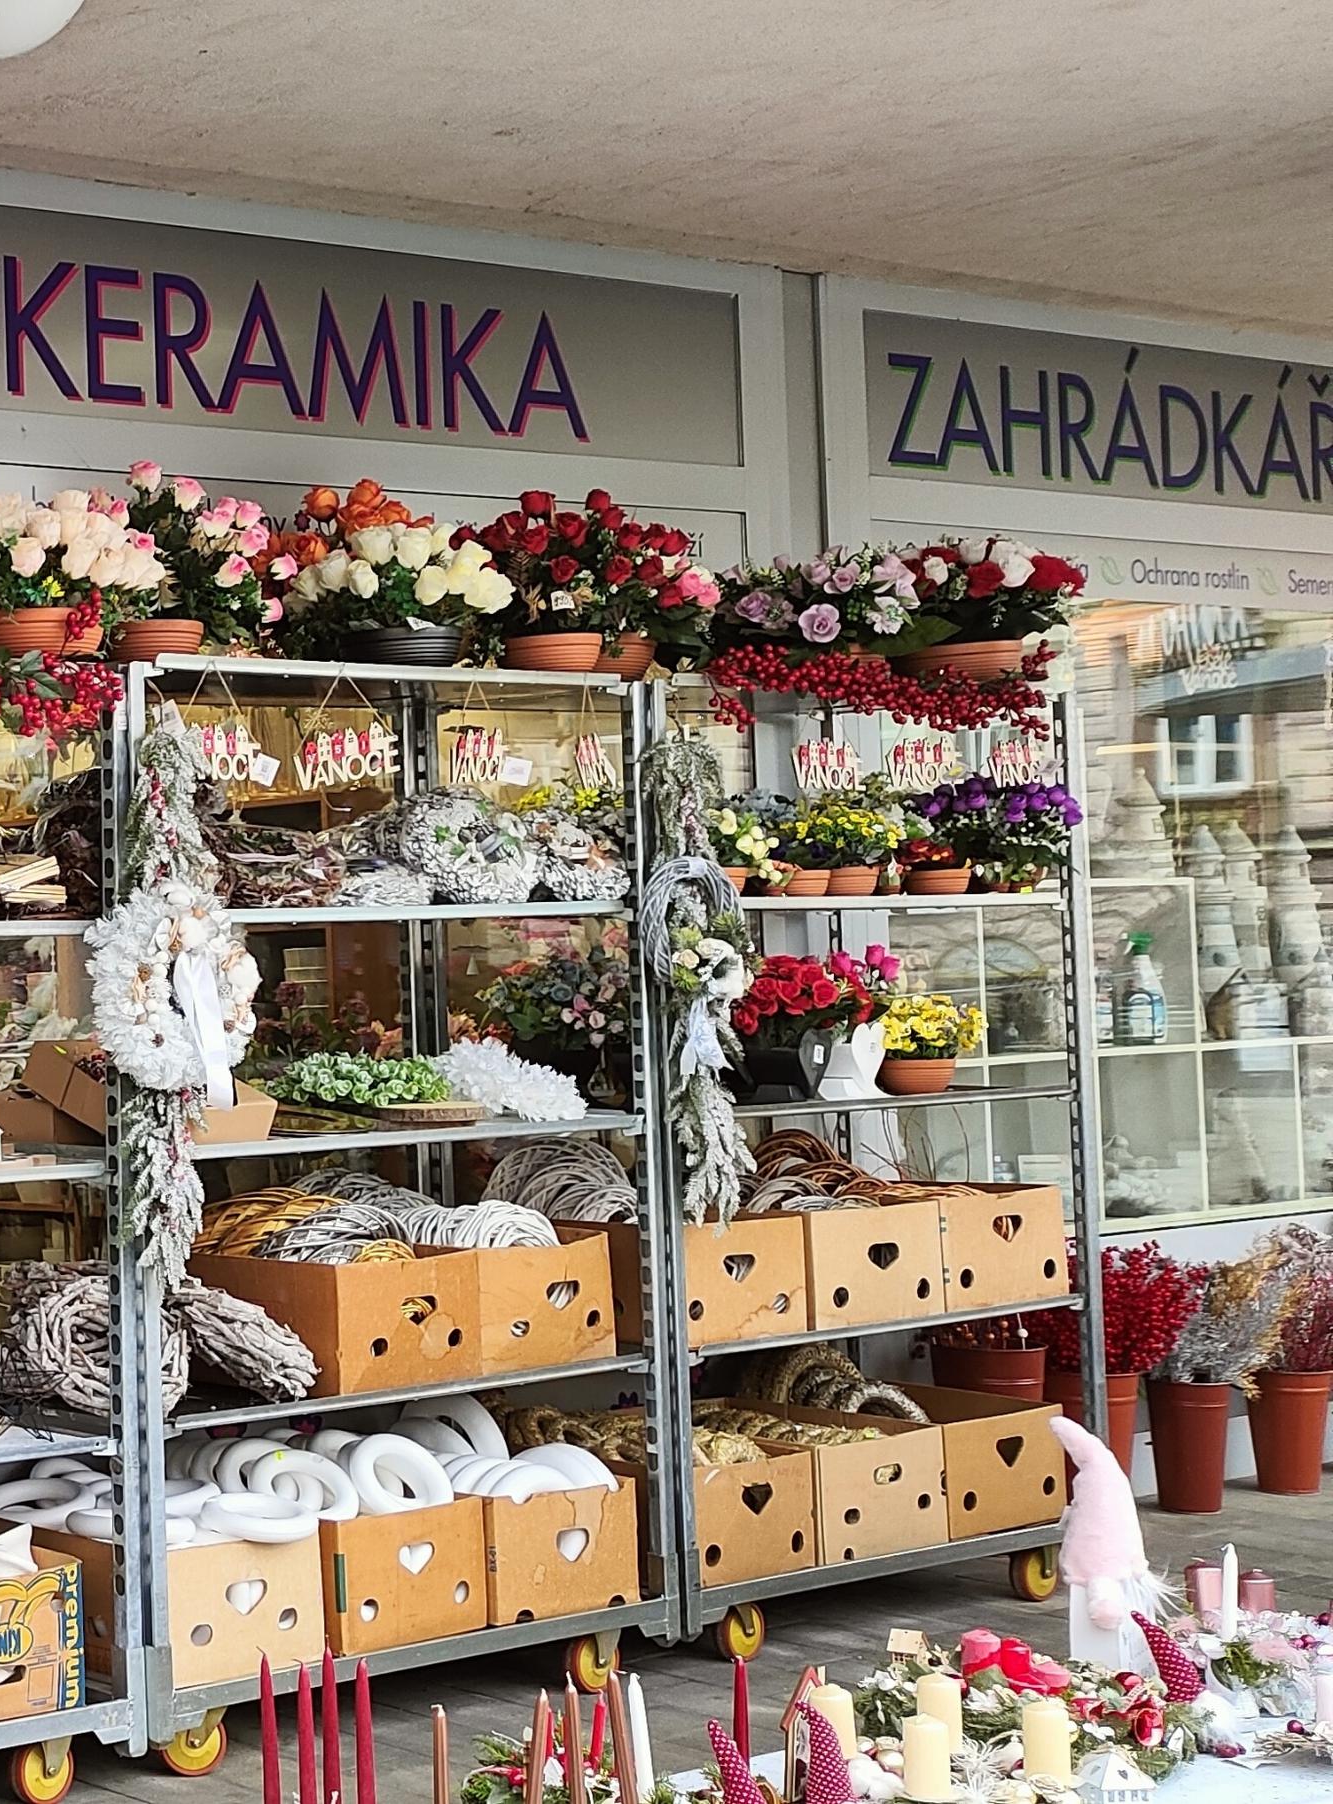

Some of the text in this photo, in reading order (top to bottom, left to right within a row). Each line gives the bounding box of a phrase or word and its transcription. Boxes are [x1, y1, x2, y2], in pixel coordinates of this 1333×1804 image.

[2, 254, 592, 444] KERAMIKA
[1131, 558, 1250, 590] Ochrana rostlin
[64, 1562, 84, 1708] premium
